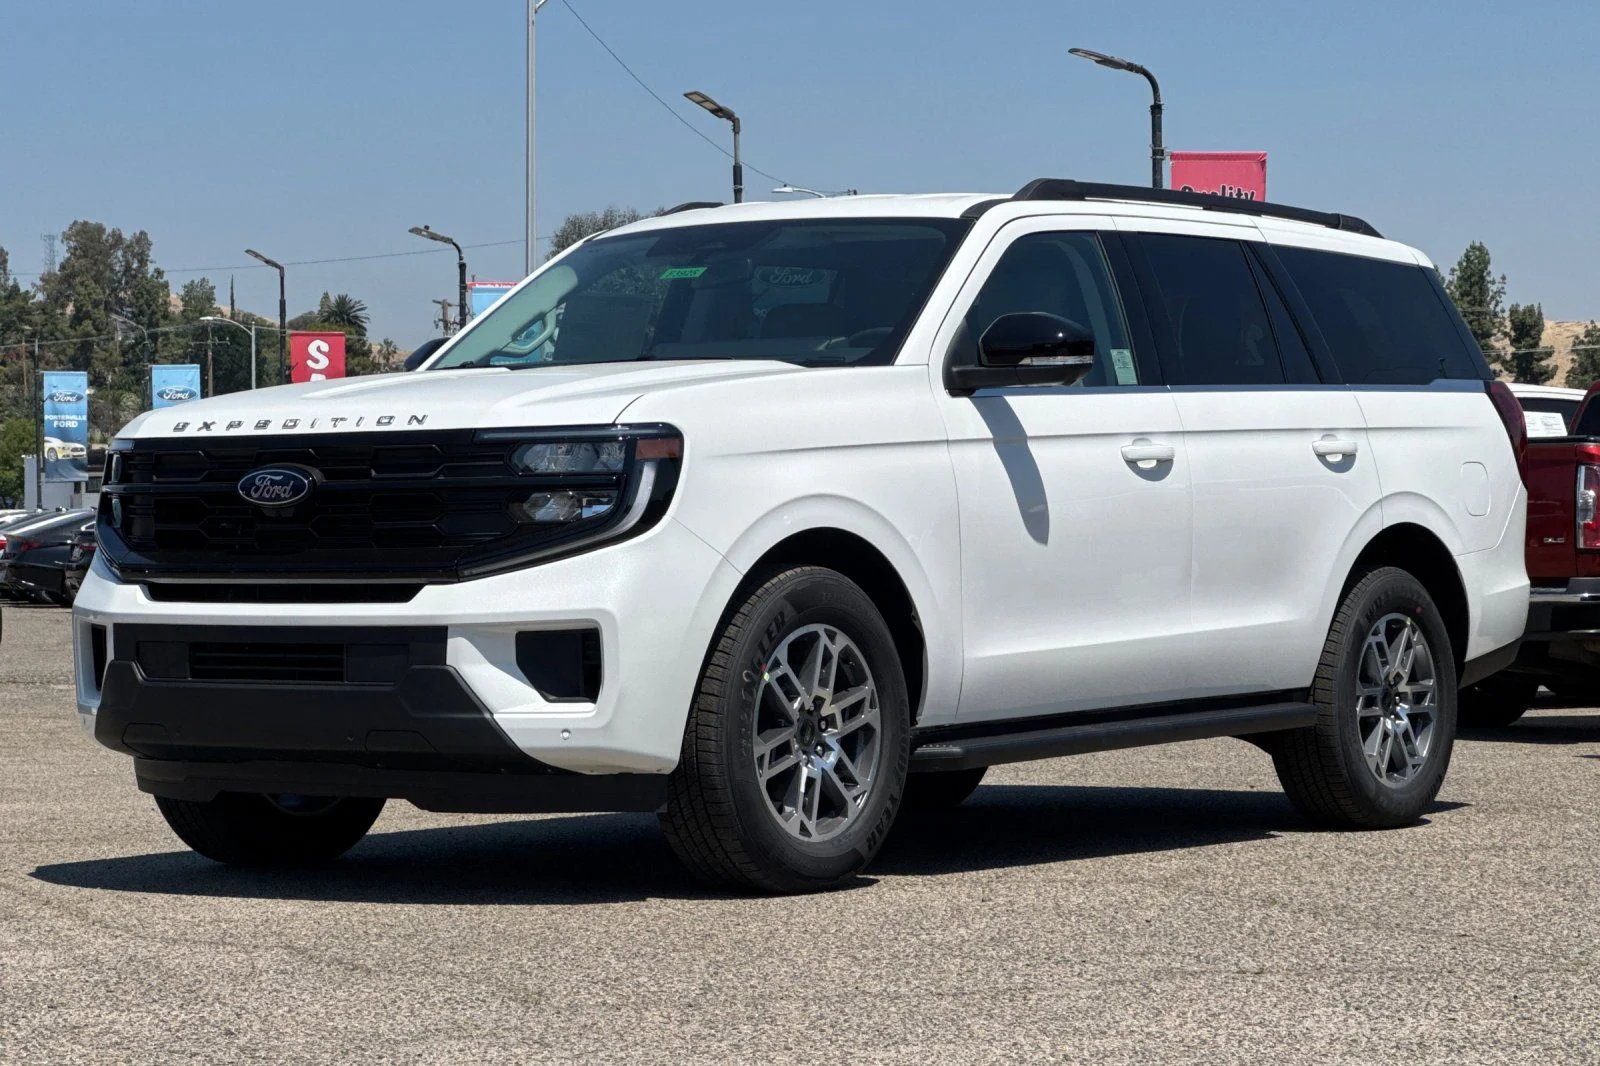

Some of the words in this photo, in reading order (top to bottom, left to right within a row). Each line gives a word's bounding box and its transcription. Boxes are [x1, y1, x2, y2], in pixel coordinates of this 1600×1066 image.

[1181, 185, 1256, 200] lity
[769, 266, 813, 285] Ford
[53, 390, 78, 402] Ford
[163, 387, 190, 400] Ford
[53, 420, 79, 428] FORD
[173, 414, 428, 433] EXPEDITION
[251, 474, 294, 499] Ford
